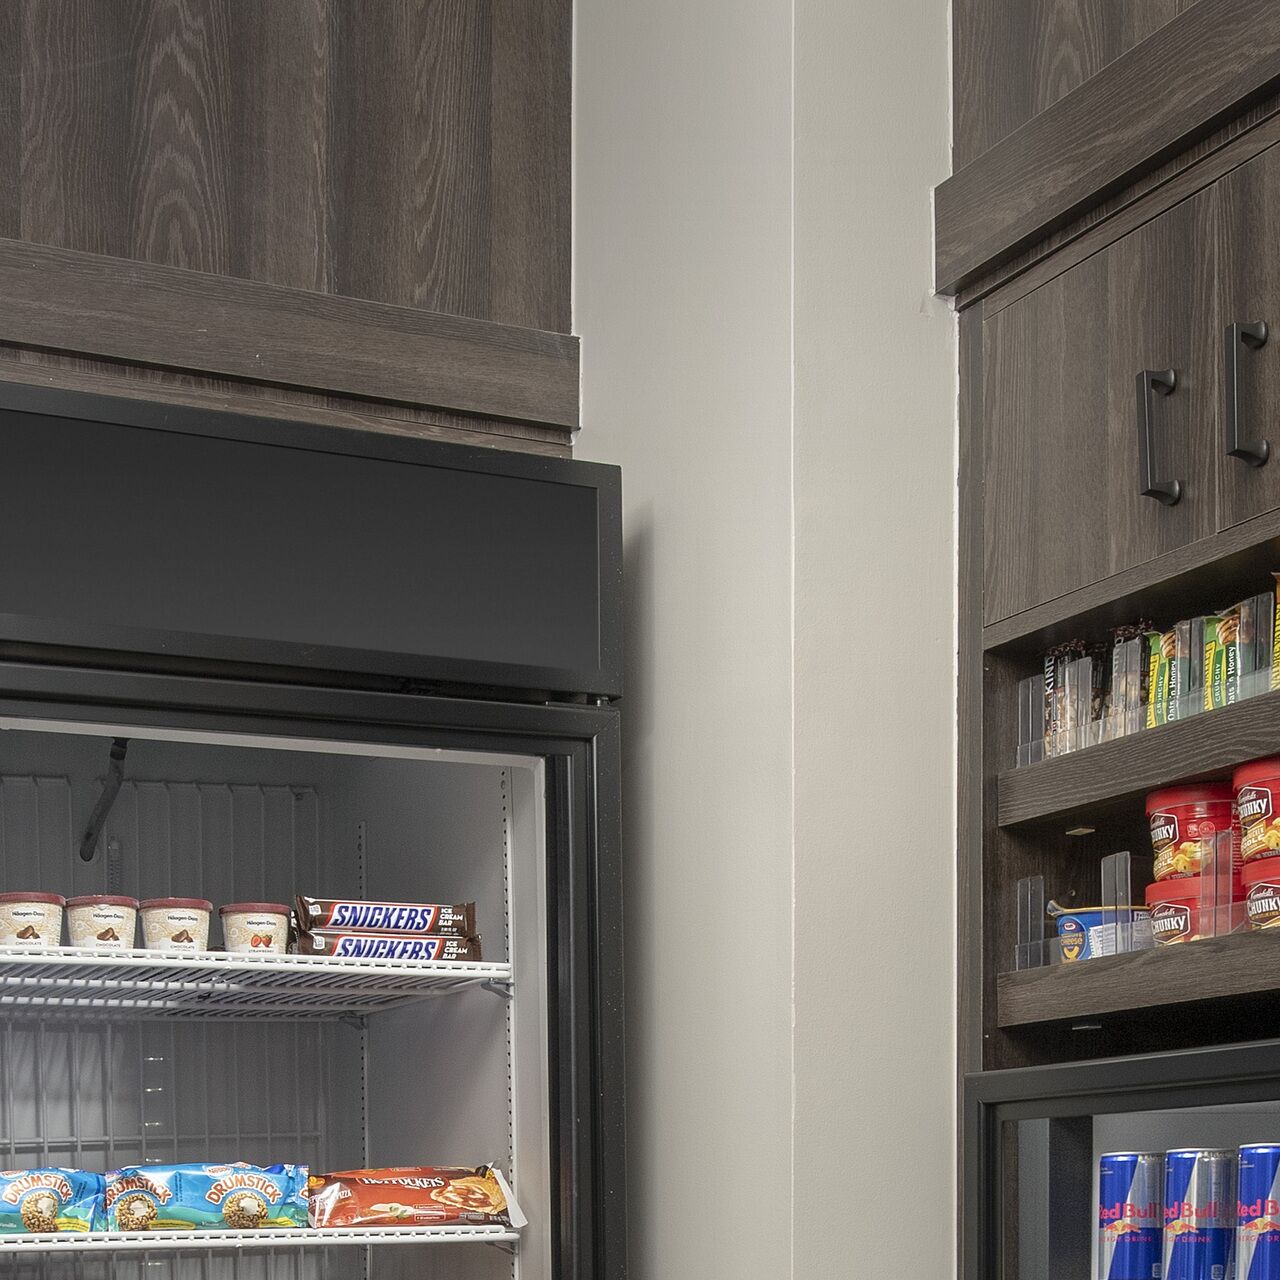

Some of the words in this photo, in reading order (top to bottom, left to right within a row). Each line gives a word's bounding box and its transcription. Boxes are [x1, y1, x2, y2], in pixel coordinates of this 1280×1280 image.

[330, 905, 431, 931] SNICKERS
[337, 938, 436, 960] SNICKERS
[2, 1174, 72, 1204] DRUMSTICK
[205, 1174, 280, 1204] DRUMSTICK
[1123, 1202, 1157, 1218] Bull
[1181, 1202, 1217, 1218] Bull
